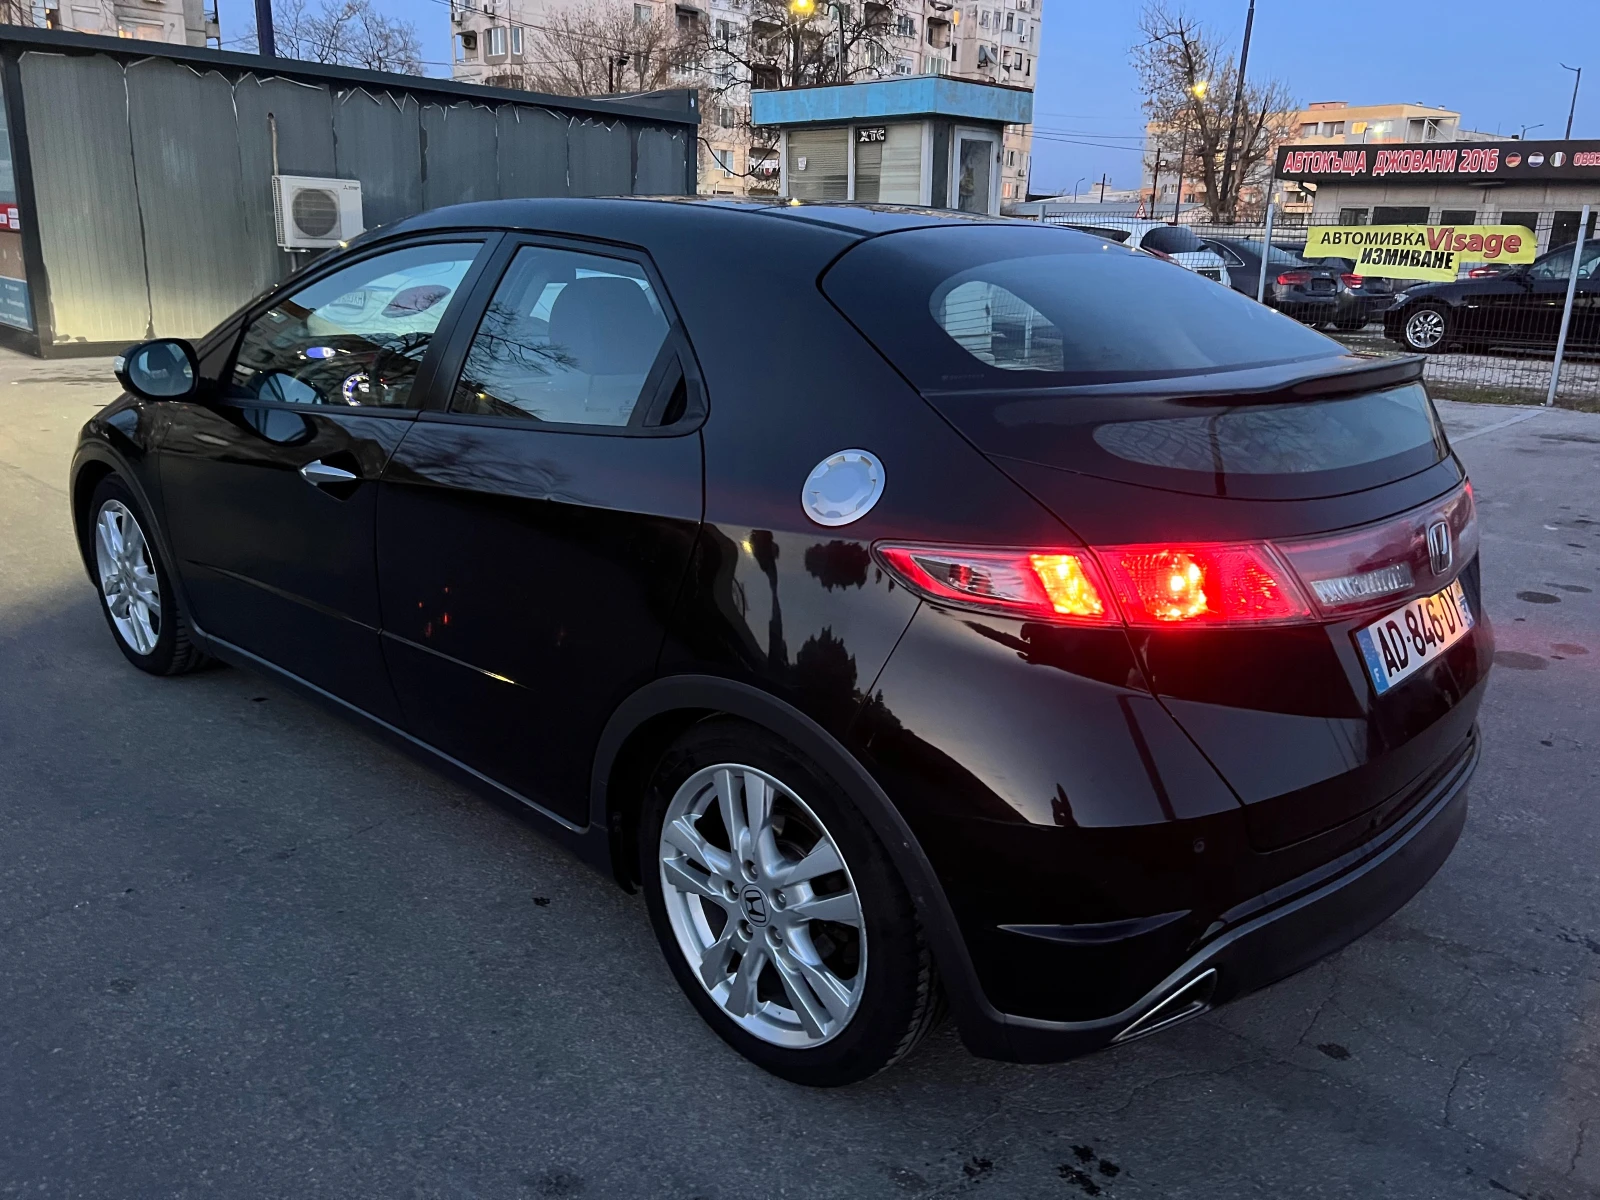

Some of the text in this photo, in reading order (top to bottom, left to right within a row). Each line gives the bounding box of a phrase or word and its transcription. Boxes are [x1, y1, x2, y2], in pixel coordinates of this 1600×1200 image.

[1283, 150, 1367, 176] АВТОКЪЩА
[1372, 149, 1457, 176] ДЖОВАНИ
[1458, 148, 1499, 173] 2016
[1320, 227, 1522, 259] АВТОМИВКА Visage
[1360, 247, 1455, 269] ИЗМИВАНЕ
